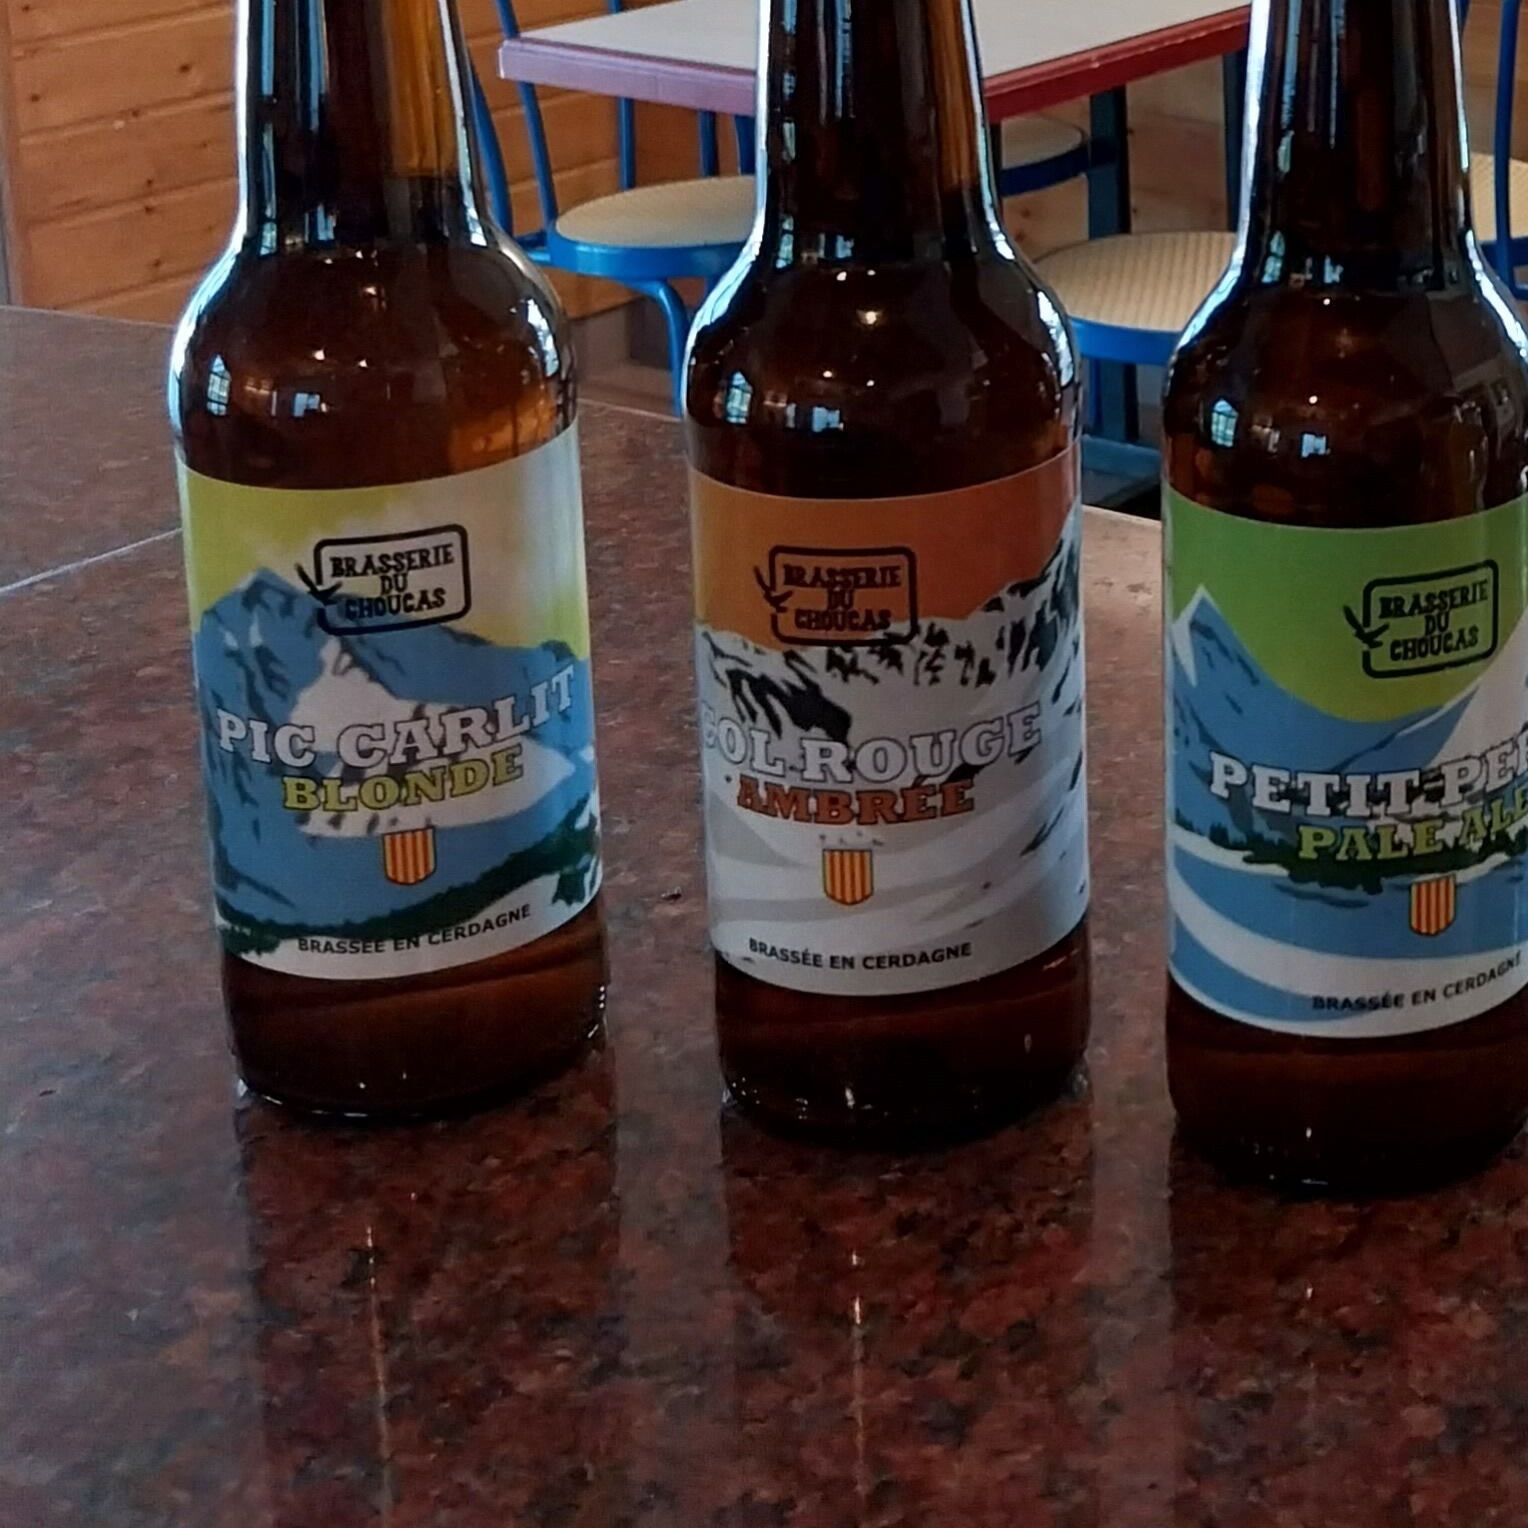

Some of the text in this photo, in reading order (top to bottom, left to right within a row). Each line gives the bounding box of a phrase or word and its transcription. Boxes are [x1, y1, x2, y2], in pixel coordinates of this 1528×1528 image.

[329, 543, 455, 578] BRASSERIE
[783, 563, 902, 589] BRASSERIE
[379, 573, 409, 595] DU
[1378, 578, 1489, 619] BRASSERIE
[343, 587, 447, 619] CHOUCAS
[794, 608, 892, 631] CHOUCAS
[1424, 611, 1450, 636] DU
[1389, 625, 1480, 662] CHOUCAS
[216, 665, 575, 769] PIC CARLIT
[801, 700, 1043, 784] ROUGE
[281, 742, 525, 814] BLONDE
[737, 773, 976, 826] AMBRÉE
[1297, 819, 1445, 861] PALE
[393, 936, 420, 952] EN
[427, 903, 531, 946] CERDAGNE
[749, 937, 972, 970] BRASSÉE EN CERDAGNE
[1312, 989, 1405, 1011] BRASSÉE
[1411, 988, 1437, 1006] EN
